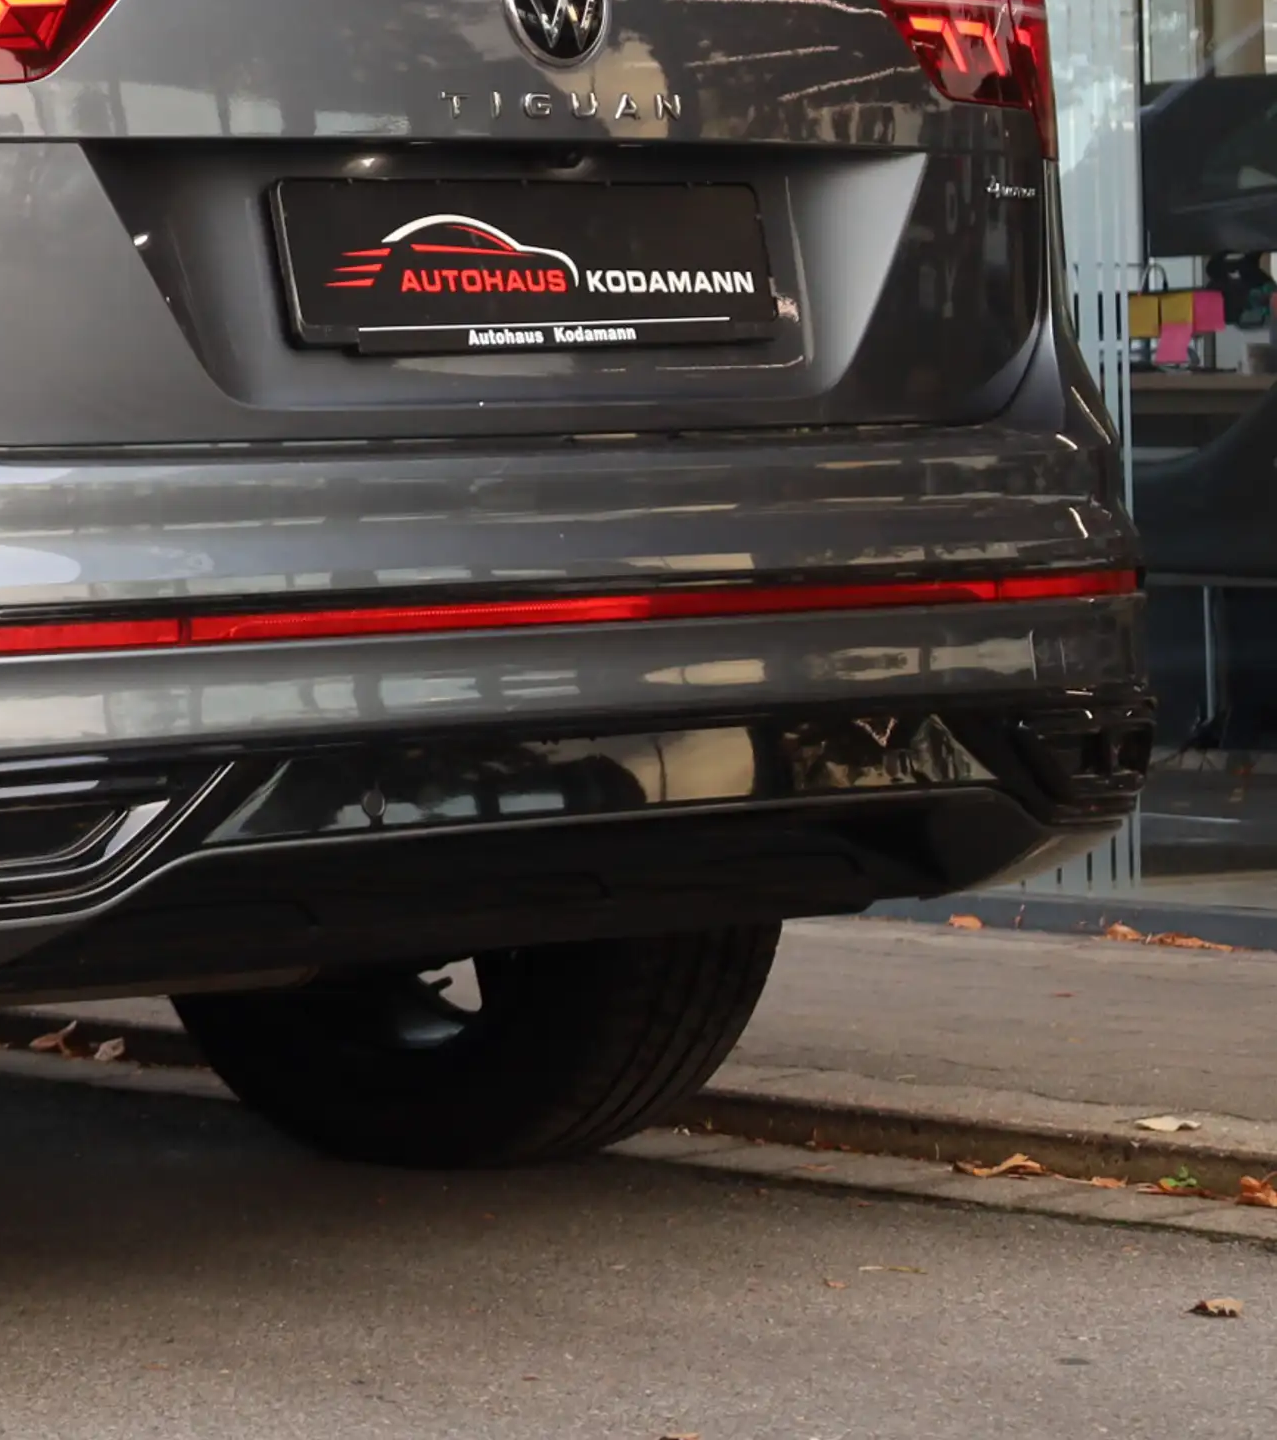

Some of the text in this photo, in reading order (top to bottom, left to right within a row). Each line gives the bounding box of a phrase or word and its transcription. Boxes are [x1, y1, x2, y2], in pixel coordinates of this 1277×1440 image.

[439, 90, 683, 120] TIGUAN
[401, 269, 755, 294] AUTOHAUS KODAMANN
[468, 326, 637, 346] Autohaus Kodamann
